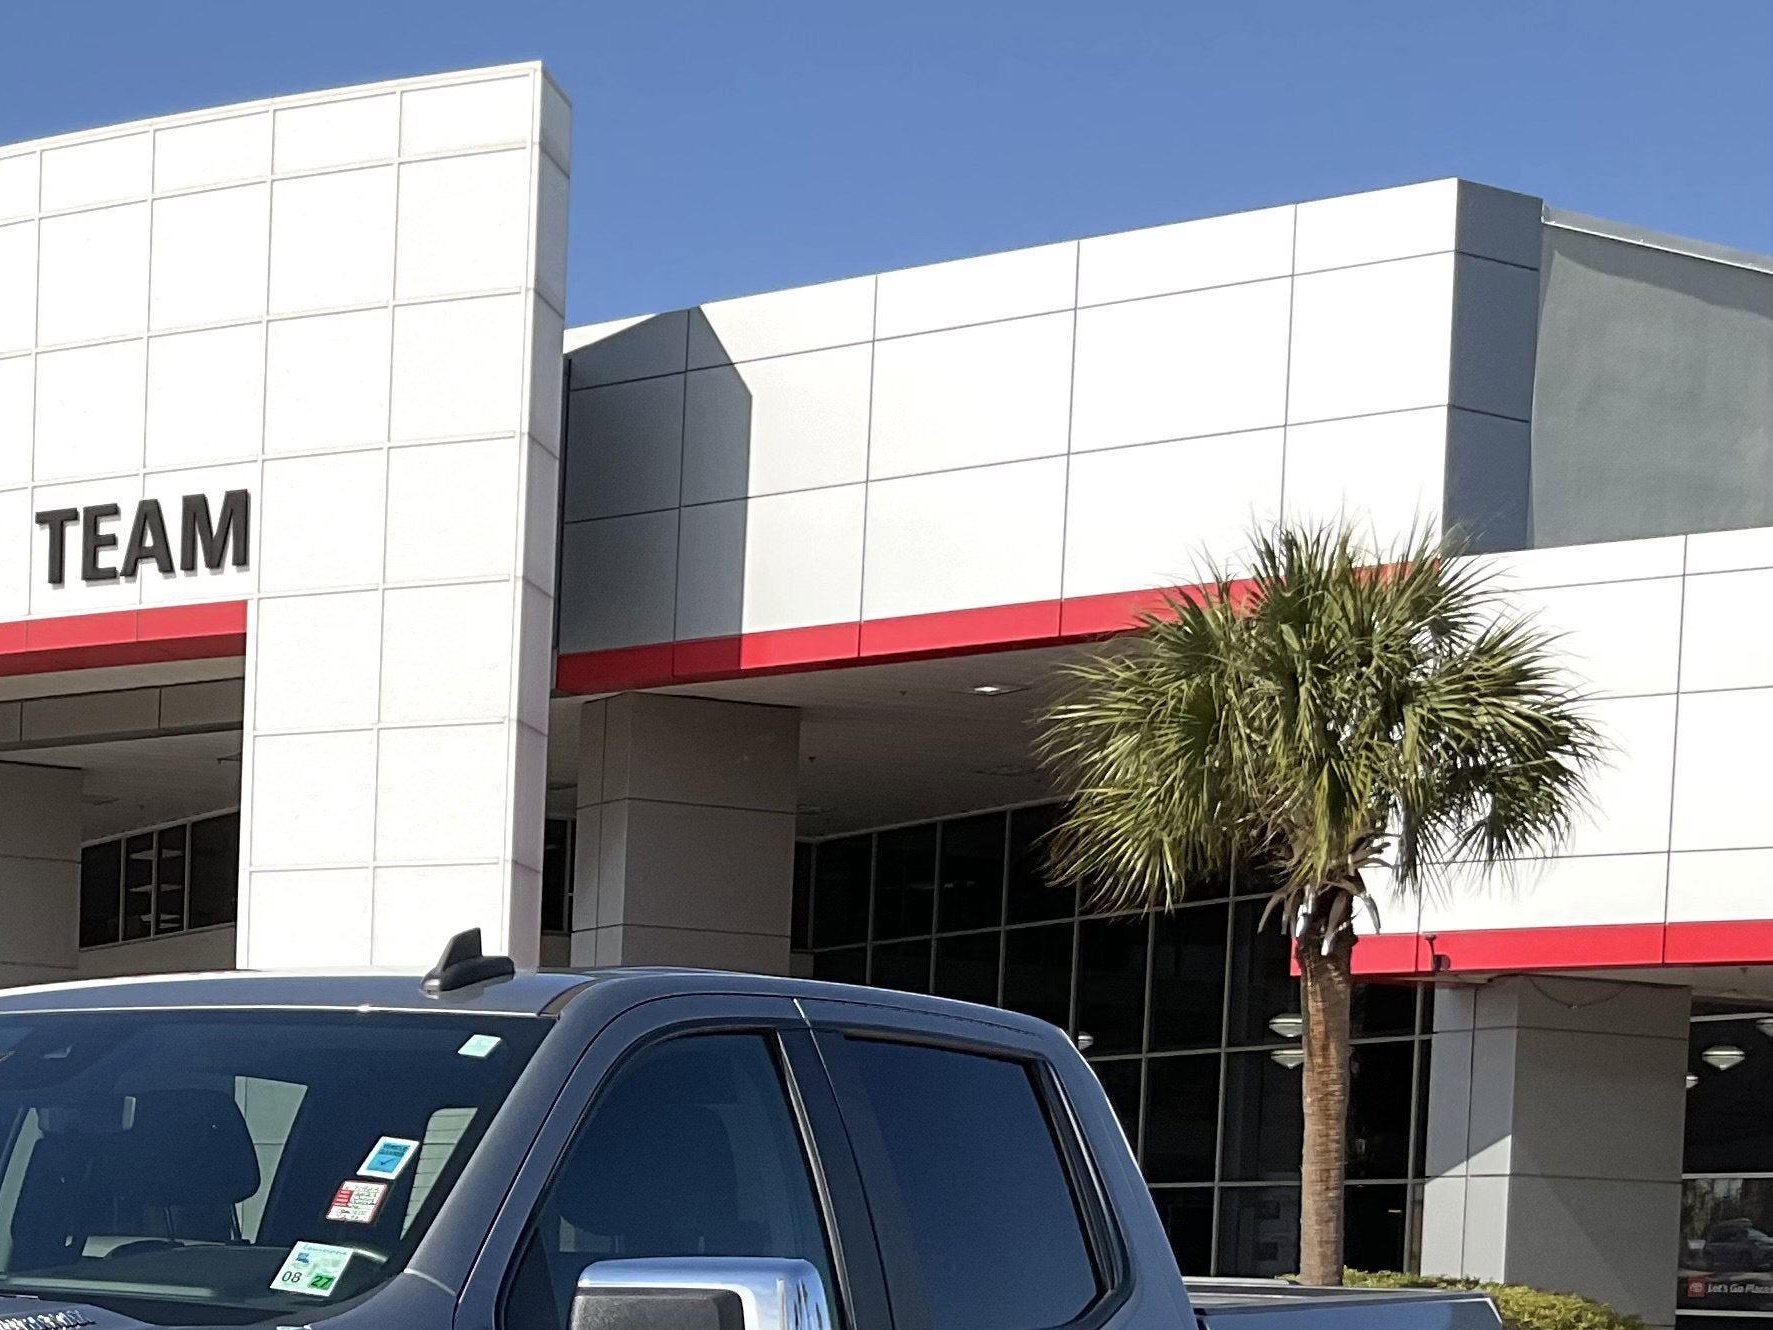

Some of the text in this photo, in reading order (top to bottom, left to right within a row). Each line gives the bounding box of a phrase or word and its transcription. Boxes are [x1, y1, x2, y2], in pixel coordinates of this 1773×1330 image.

[35, 488, 249, 585] TEAM
[281, 1270, 335, 1288] 08 27
[1707, 1283, 1728, 1293] Let's
[1730, 1283, 1744, 1293] Go
